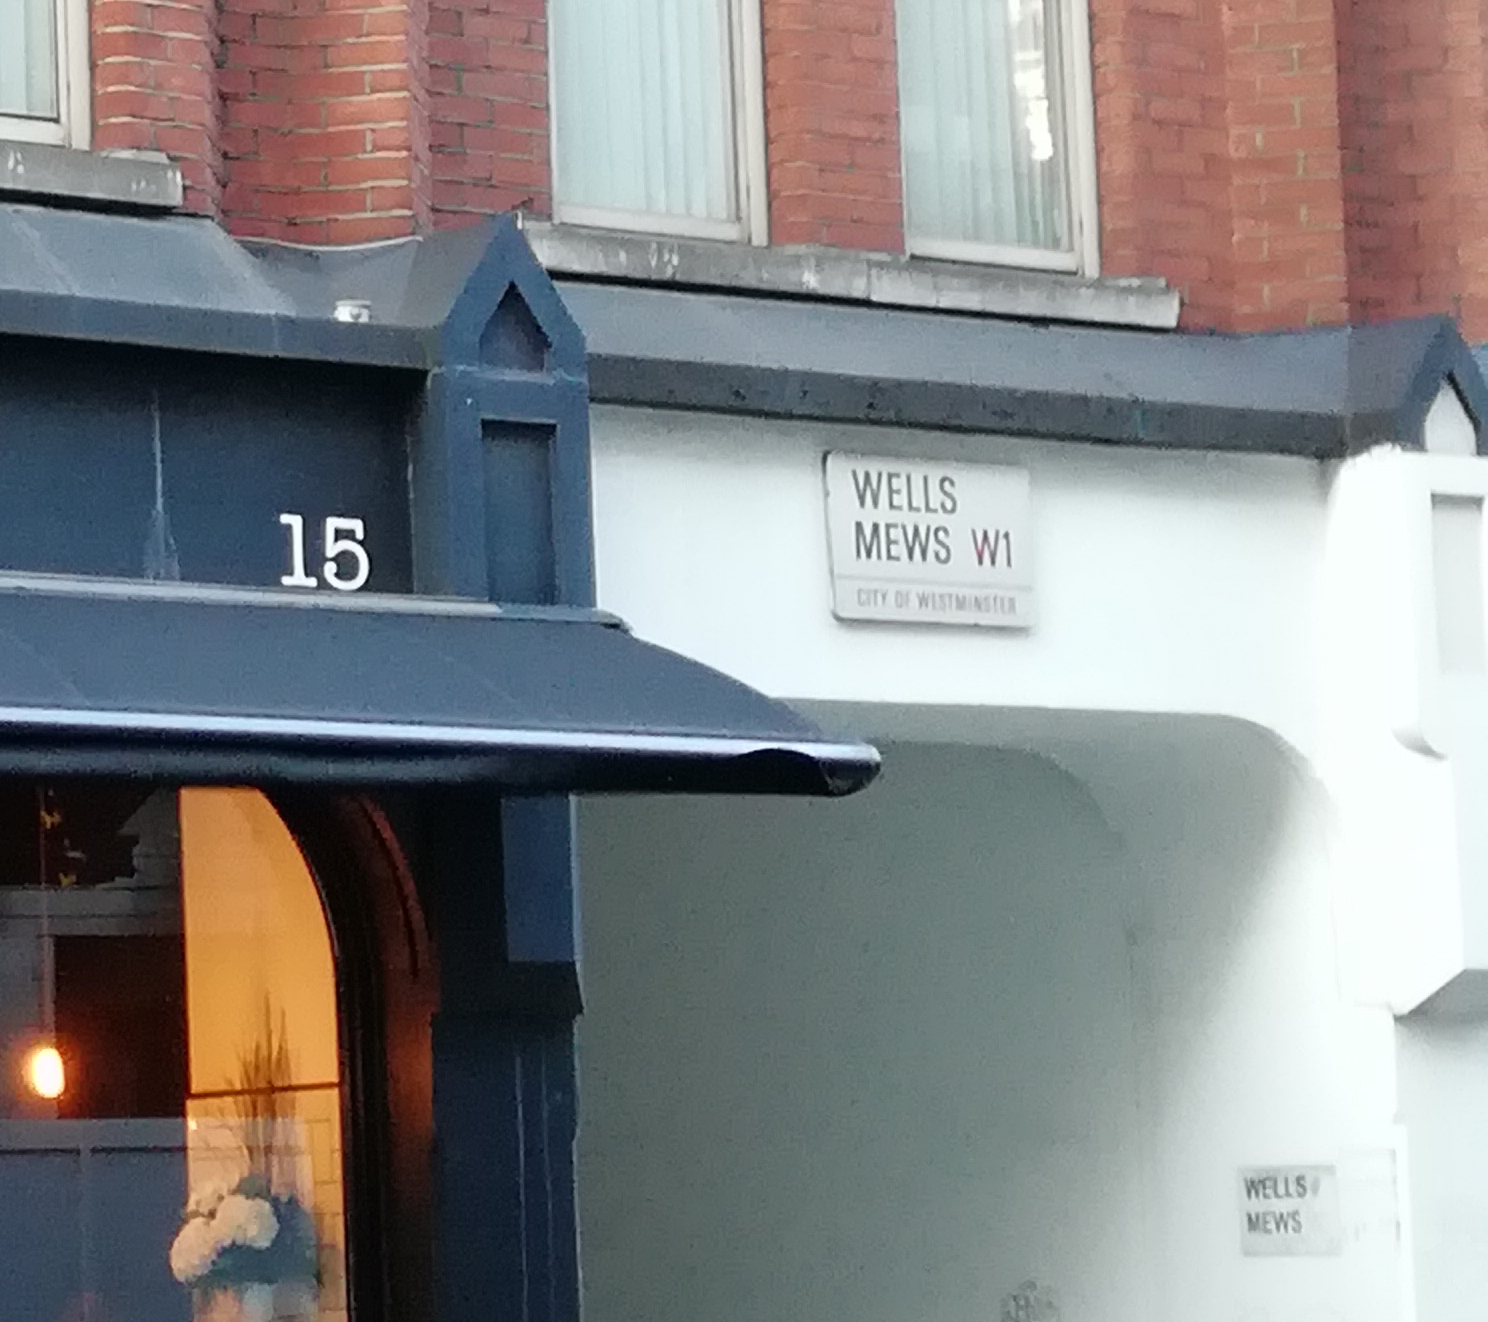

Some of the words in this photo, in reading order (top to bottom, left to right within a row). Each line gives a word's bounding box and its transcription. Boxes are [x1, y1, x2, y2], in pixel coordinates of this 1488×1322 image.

[851, 468, 958, 515] WELLS
[278, 512, 371, 592] 15
[854, 520, 952, 565] MEWS
[970, 527, 1013, 569] W1
[857, 587, 889, 608] CITY
[894, 589, 911, 610] OF
[915, 591, 1017, 615] WESTMINSTER
[1243, 1174, 1308, 1201] WELLS
